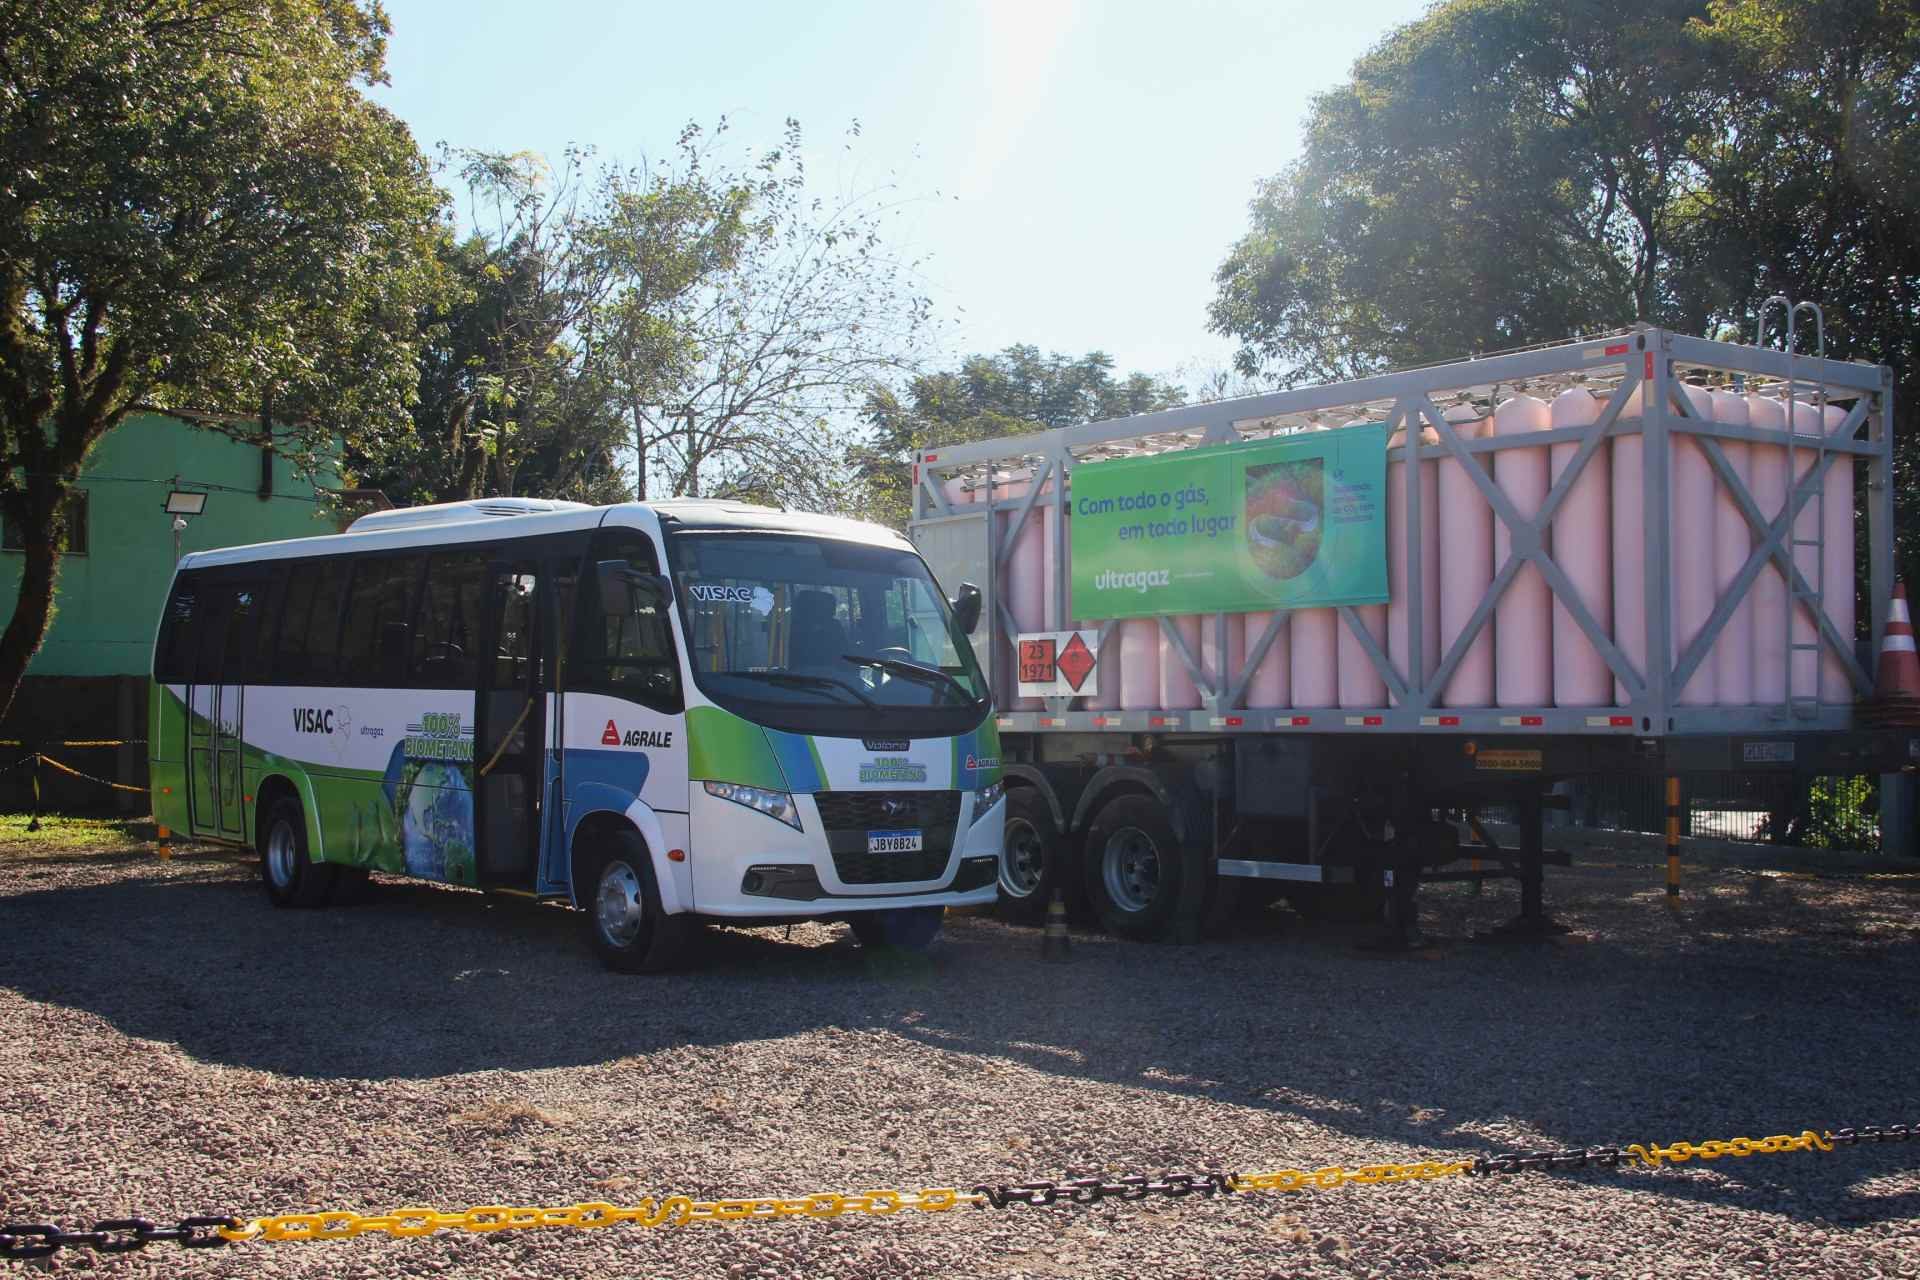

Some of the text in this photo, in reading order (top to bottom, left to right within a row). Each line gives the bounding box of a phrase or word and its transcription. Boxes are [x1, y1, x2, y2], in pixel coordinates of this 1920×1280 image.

[1078, 484, 1209, 515] Com todo o gás,
[1119, 513, 1237, 541] em todo lugar
[1095, 568, 1170, 594] ultragaz
[689, 585, 752, 603] VISAC
[1029, 645, 1045, 660] 23
[1022, 663, 1052, 679] 1971
[293, 707, 334, 734] VISAC
[423, 712, 461, 737] 100%
[360, 725, 384, 739] ultragaz
[623, 729, 672, 748] AGRALE
